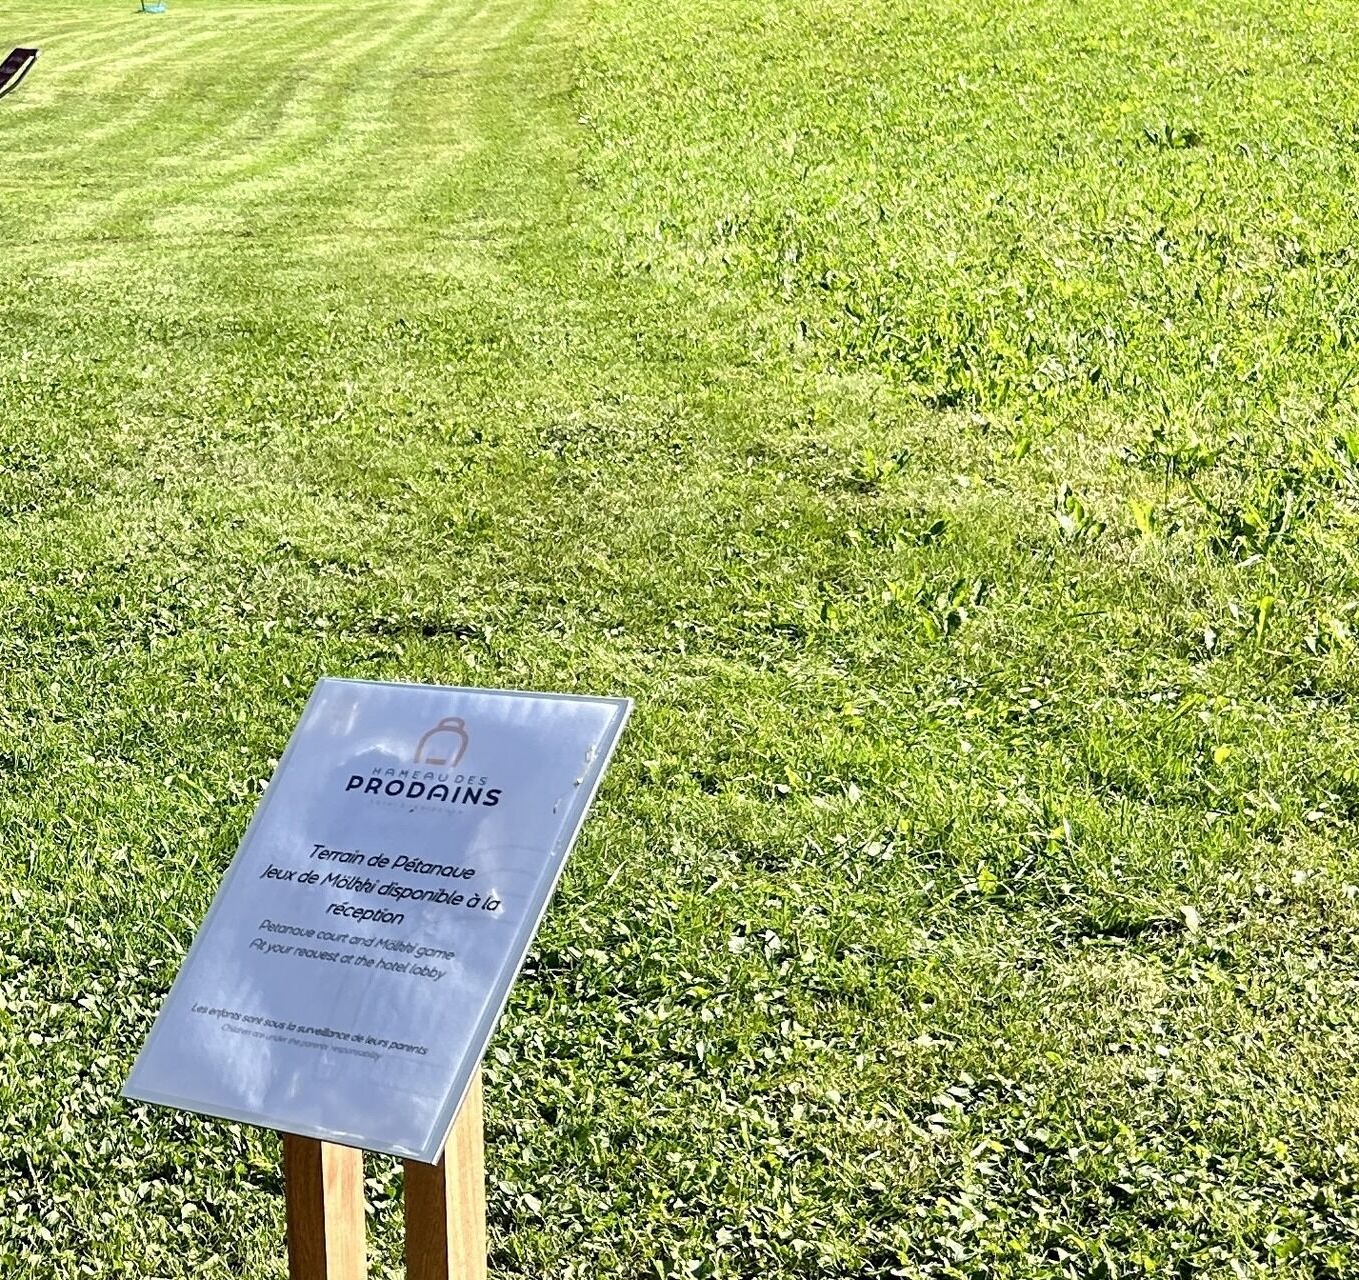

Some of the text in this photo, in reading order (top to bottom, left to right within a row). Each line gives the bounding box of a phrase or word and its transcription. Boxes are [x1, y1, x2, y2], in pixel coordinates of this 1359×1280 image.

[345, 775, 502, 807] PRODAINS
[372, 767, 488, 786] HAMEAU DES
[309, 844, 364, 865] Terrain
[367, 853, 389, 869] de
[259, 864, 295, 881] Jeux
[297, 869, 320, 885] de
[377, 881, 464, 906] disponible
[465, 892, 481, 909] à
[481, 895, 501, 911] la
[325, 901, 405, 926] réception
[249, 937, 267, 951] At
[263, 944, 294, 955] your
[340, 954, 355, 965] at
[354, 954, 375, 968] the
[375, 957, 409, 973] hotel
[409, 964, 447, 981] lobby
[316, 930, 348, 943] court
[348, 935, 376, 948] and
[414, 946, 456, 960] game
[191, 1002, 209, 1014] Les
[242, 1014, 263, 1025] sont
[263, 1018, 286, 1030] sous
[286, 1022, 297, 1031] la
[350, 1033, 365, 1043] de
[365, 1036, 389, 1048] leurs
[387, 1041, 429, 1055] parents
